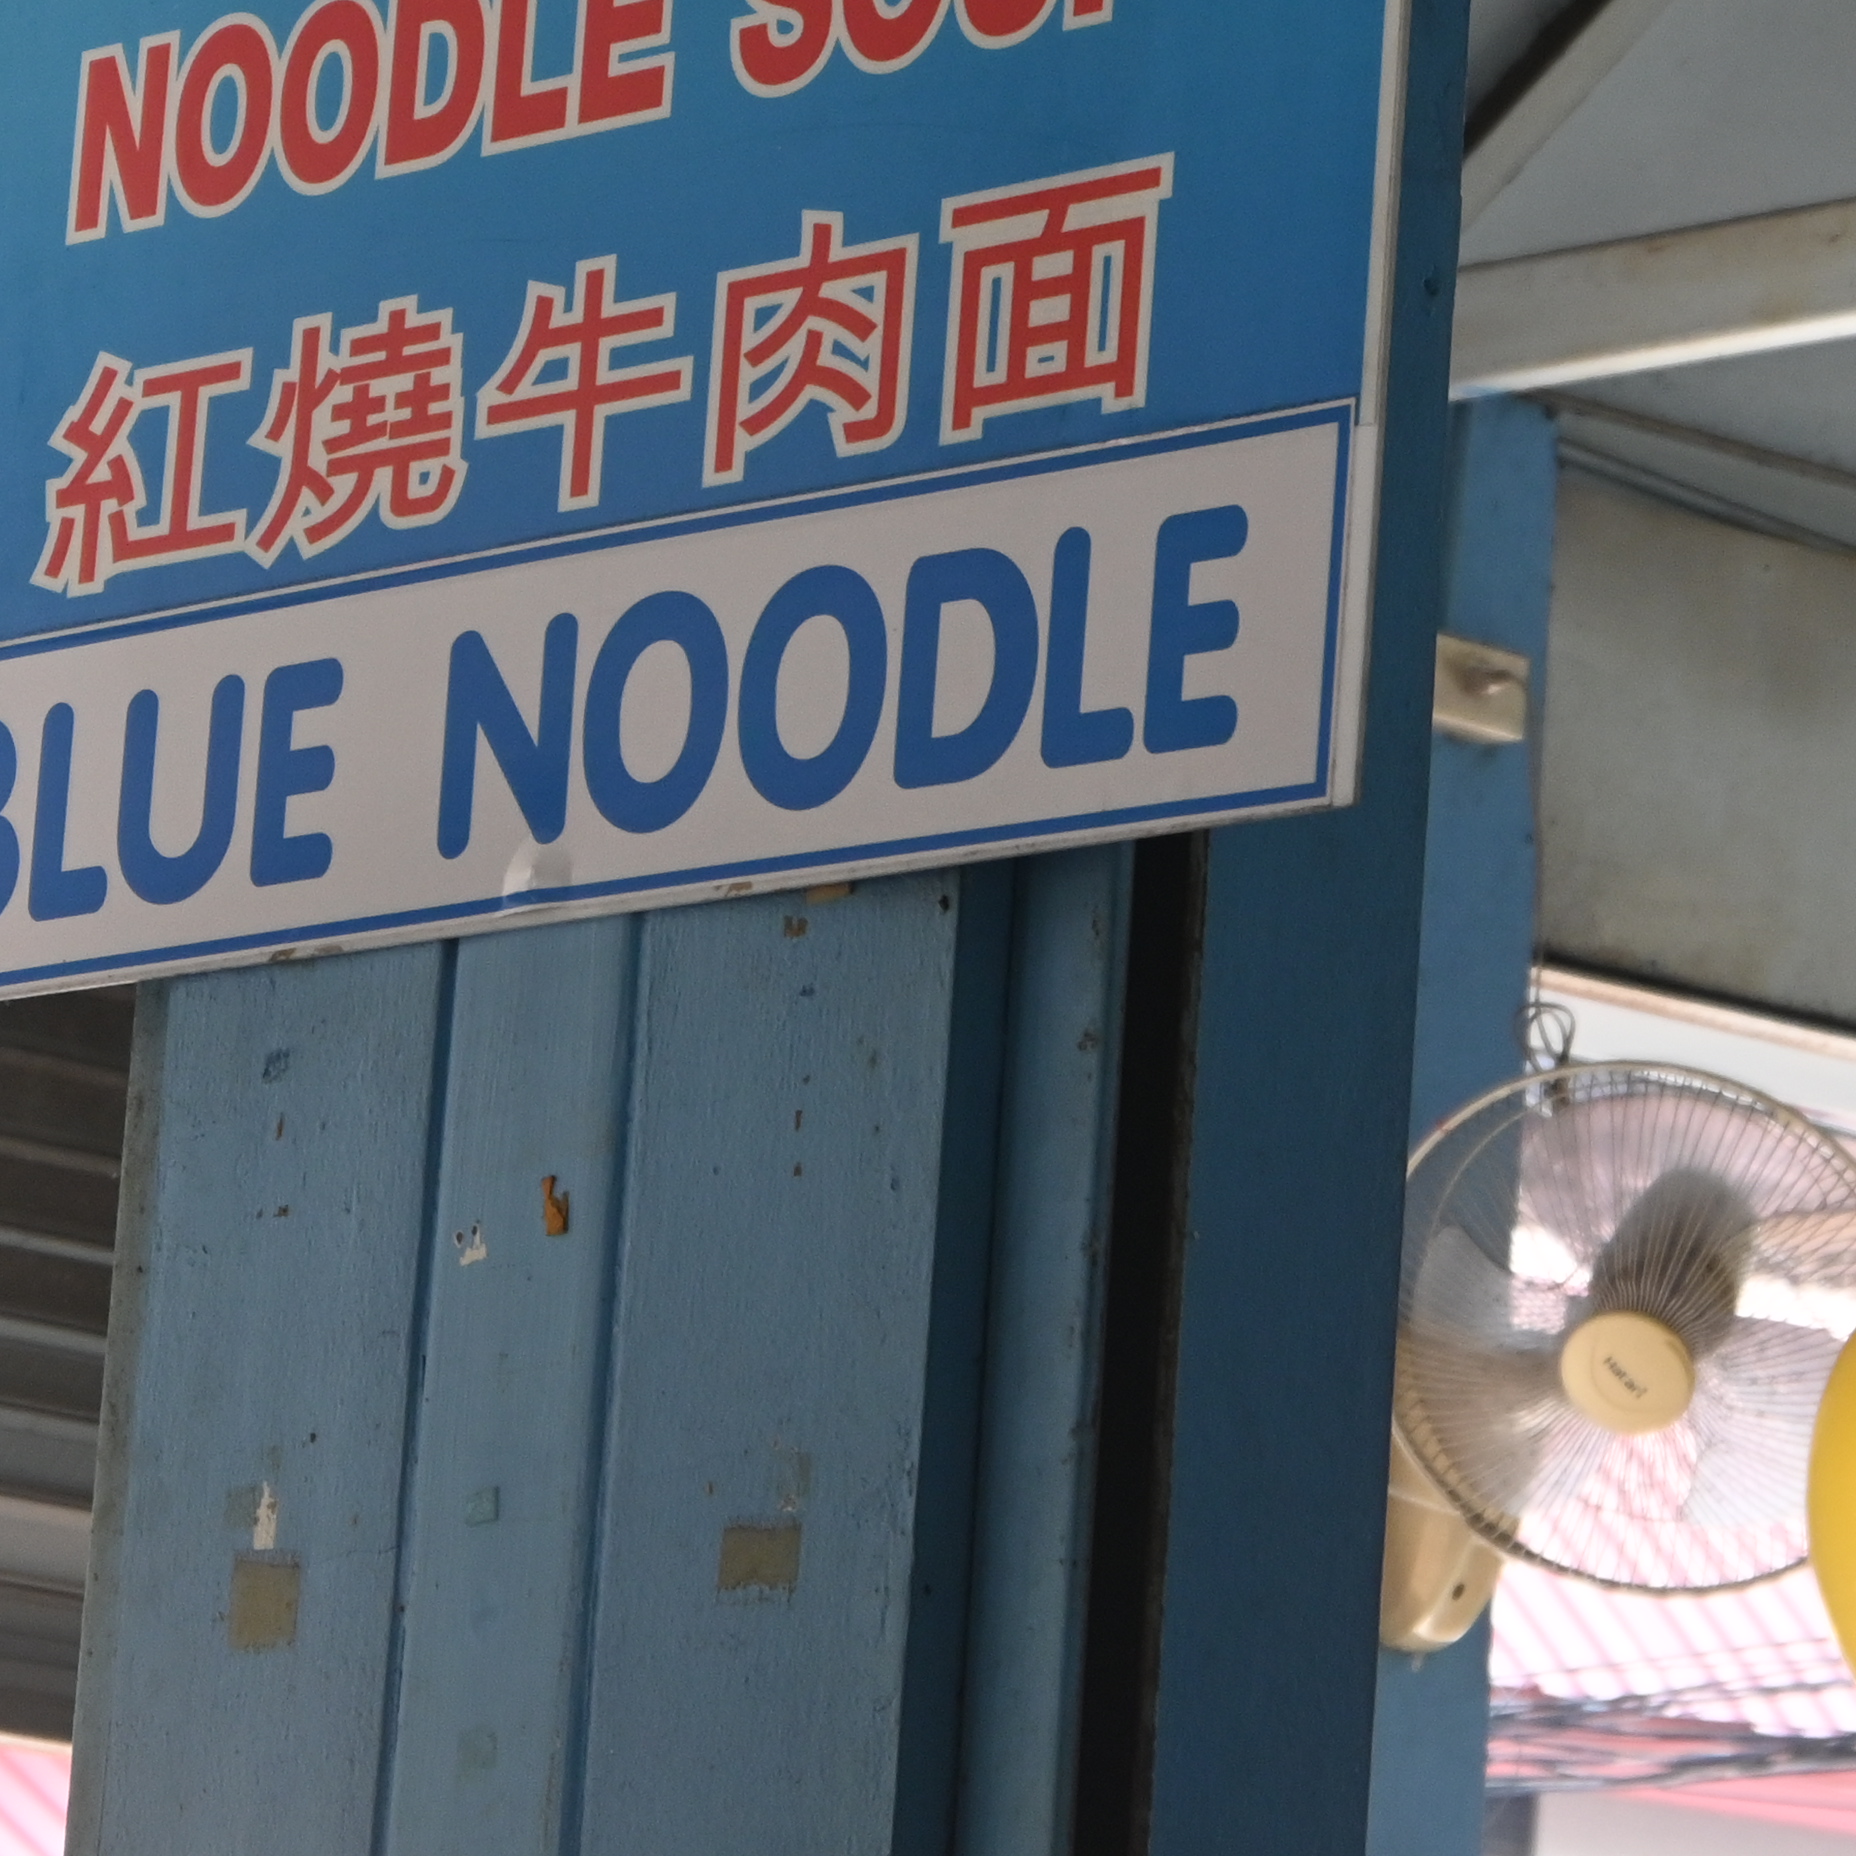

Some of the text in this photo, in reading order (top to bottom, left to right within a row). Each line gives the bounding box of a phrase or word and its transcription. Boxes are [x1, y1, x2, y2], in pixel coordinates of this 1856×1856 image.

[31, 154, 1175, 595] 紅燒牛肉面
[436, 503, 1250, 860] NOODLE
